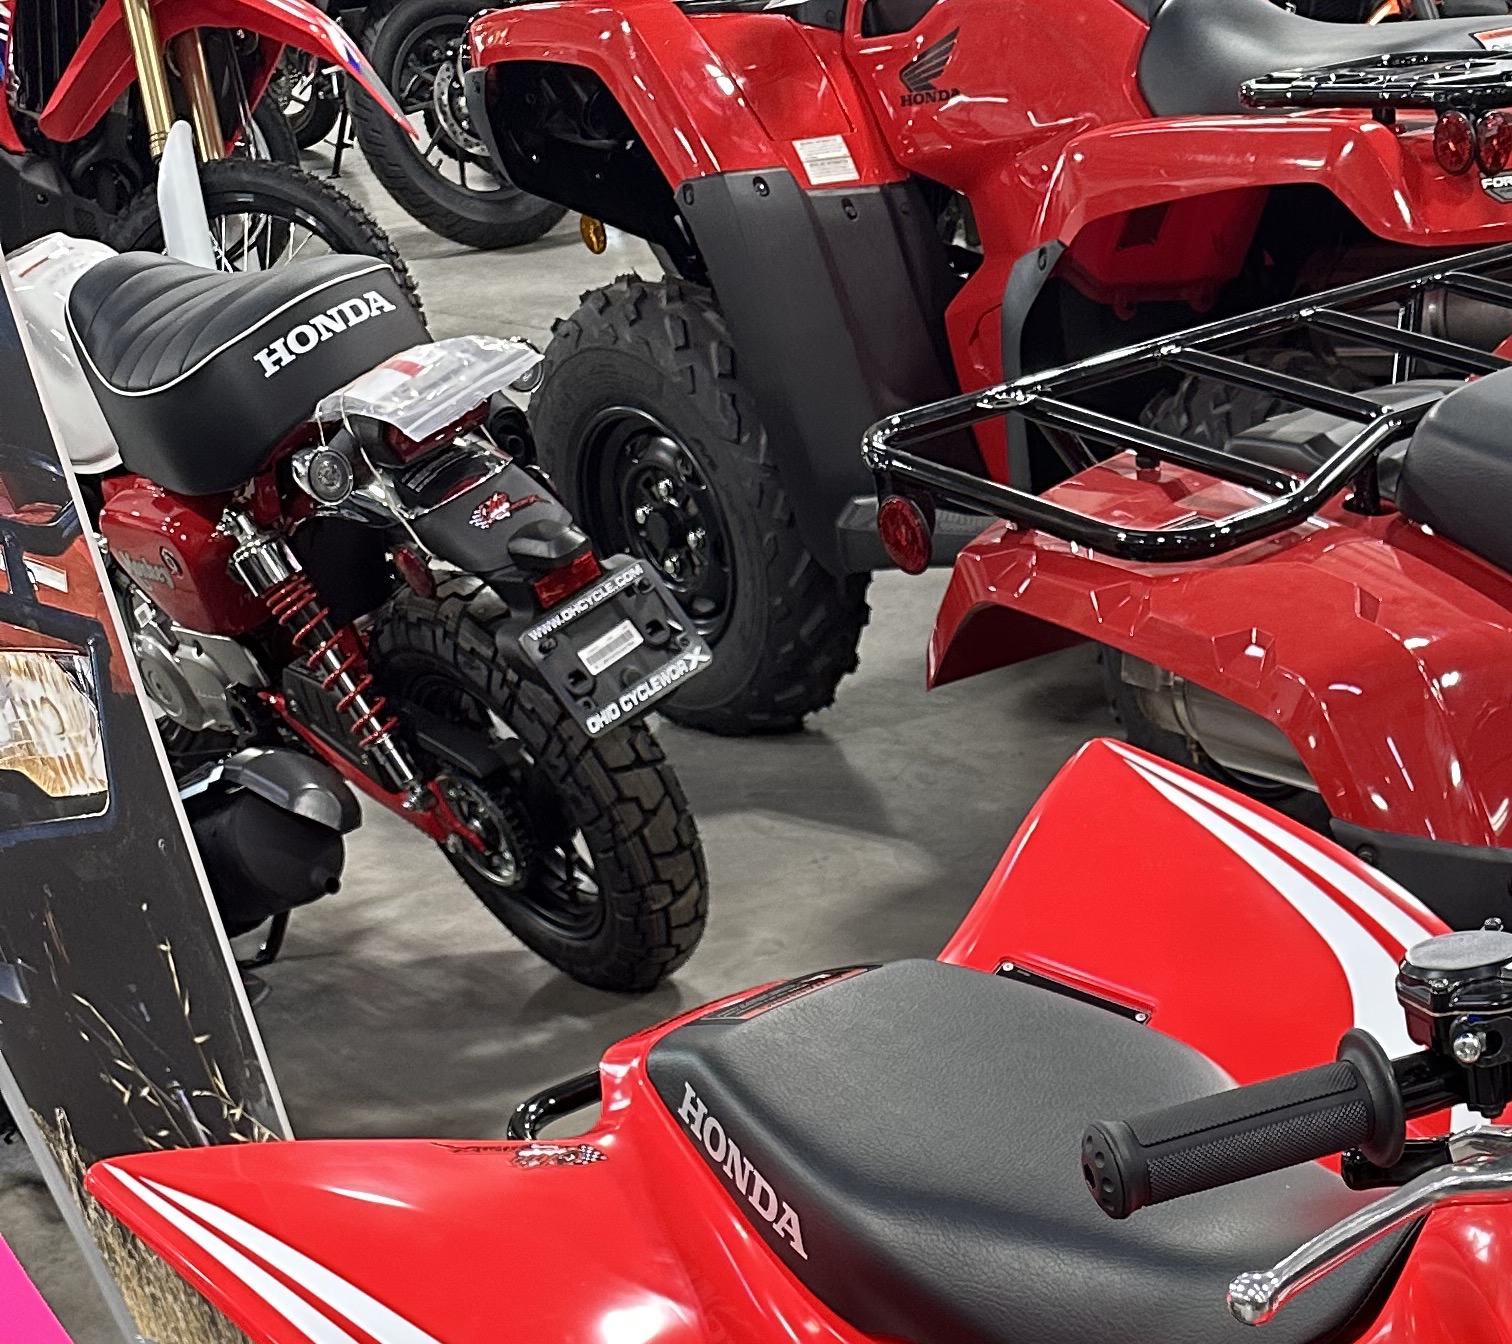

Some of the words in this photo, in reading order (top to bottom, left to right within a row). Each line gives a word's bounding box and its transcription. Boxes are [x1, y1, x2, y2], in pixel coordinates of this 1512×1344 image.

[899, 88, 961, 107] HONDA
[253, 290, 397, 378] HONDA
[527, 563, 644, 641] WWW.OHCYCLE.COM
[586, 702, 621, 734] OHIO
[618, 646, 711, 713] CYCLEWORX
[677, 1081, 808, 1261] HONDA
